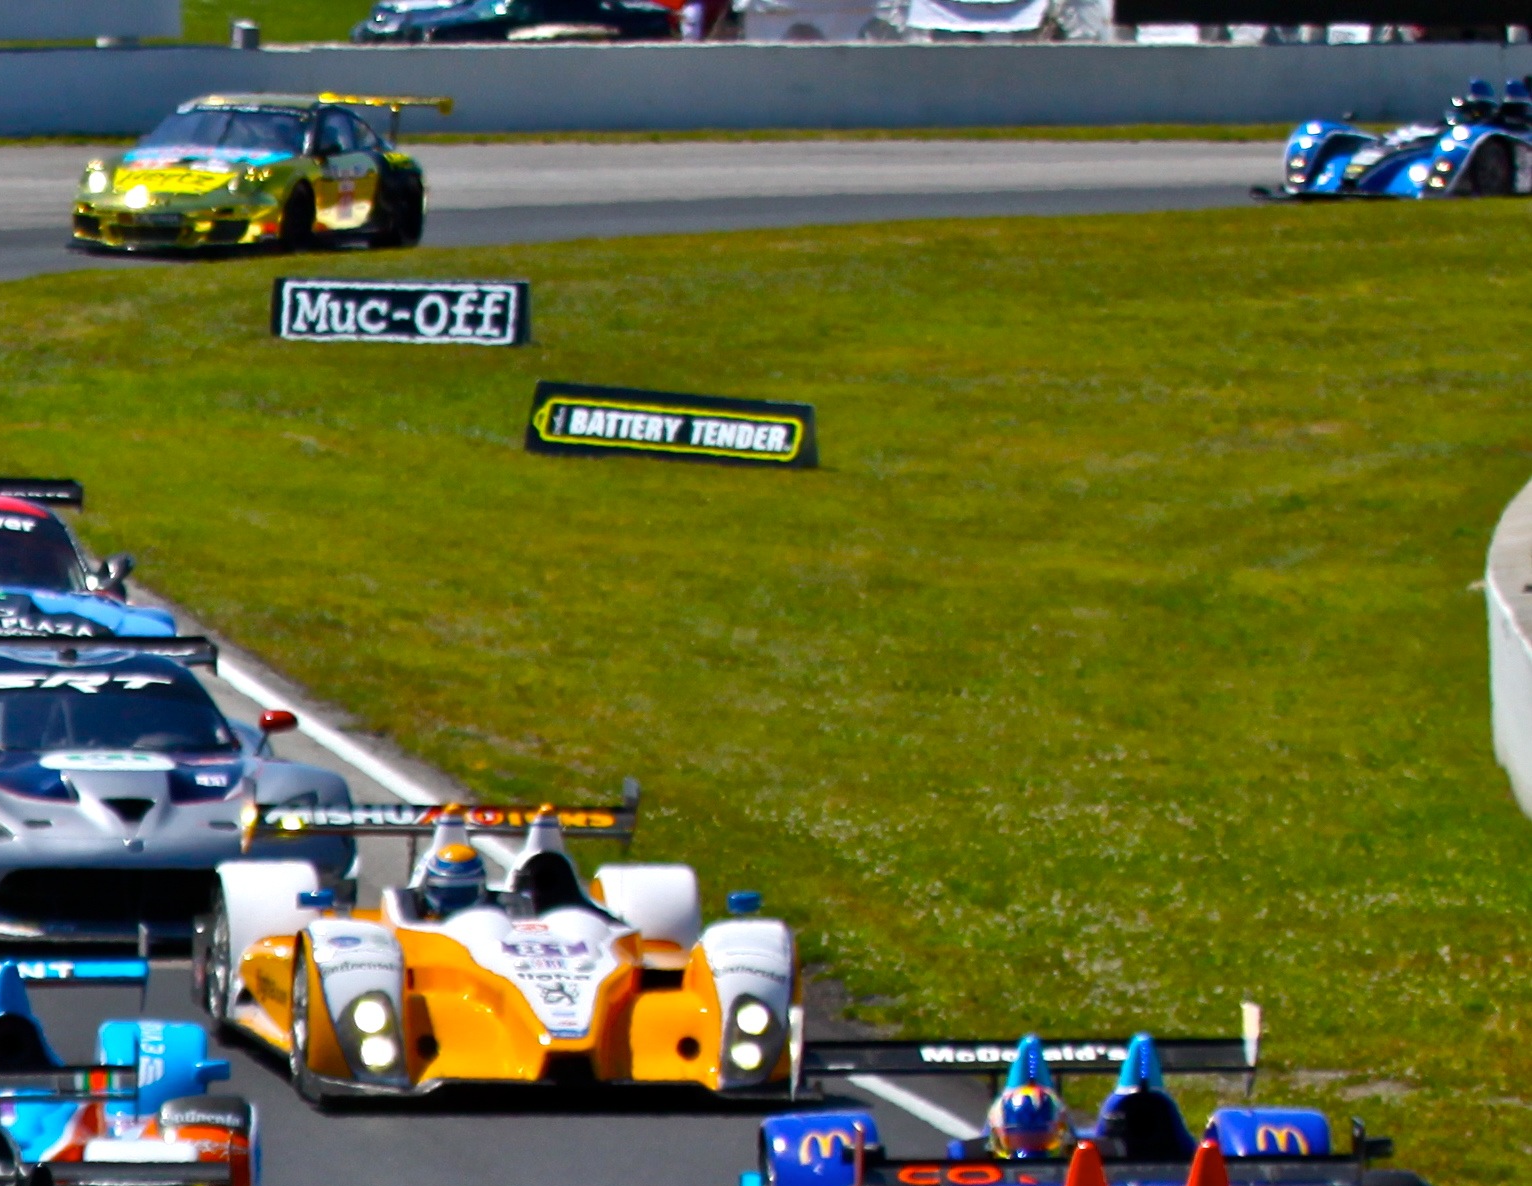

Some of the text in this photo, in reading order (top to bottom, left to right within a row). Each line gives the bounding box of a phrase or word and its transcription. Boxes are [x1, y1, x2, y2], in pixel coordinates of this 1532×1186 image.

[292, 290, 506, 336] Muc-Off
[568, 408, 680, 444] BATTERY
[690, 416, 789, 453] TENDER
[0, 617, 94, 637] PLAZA
